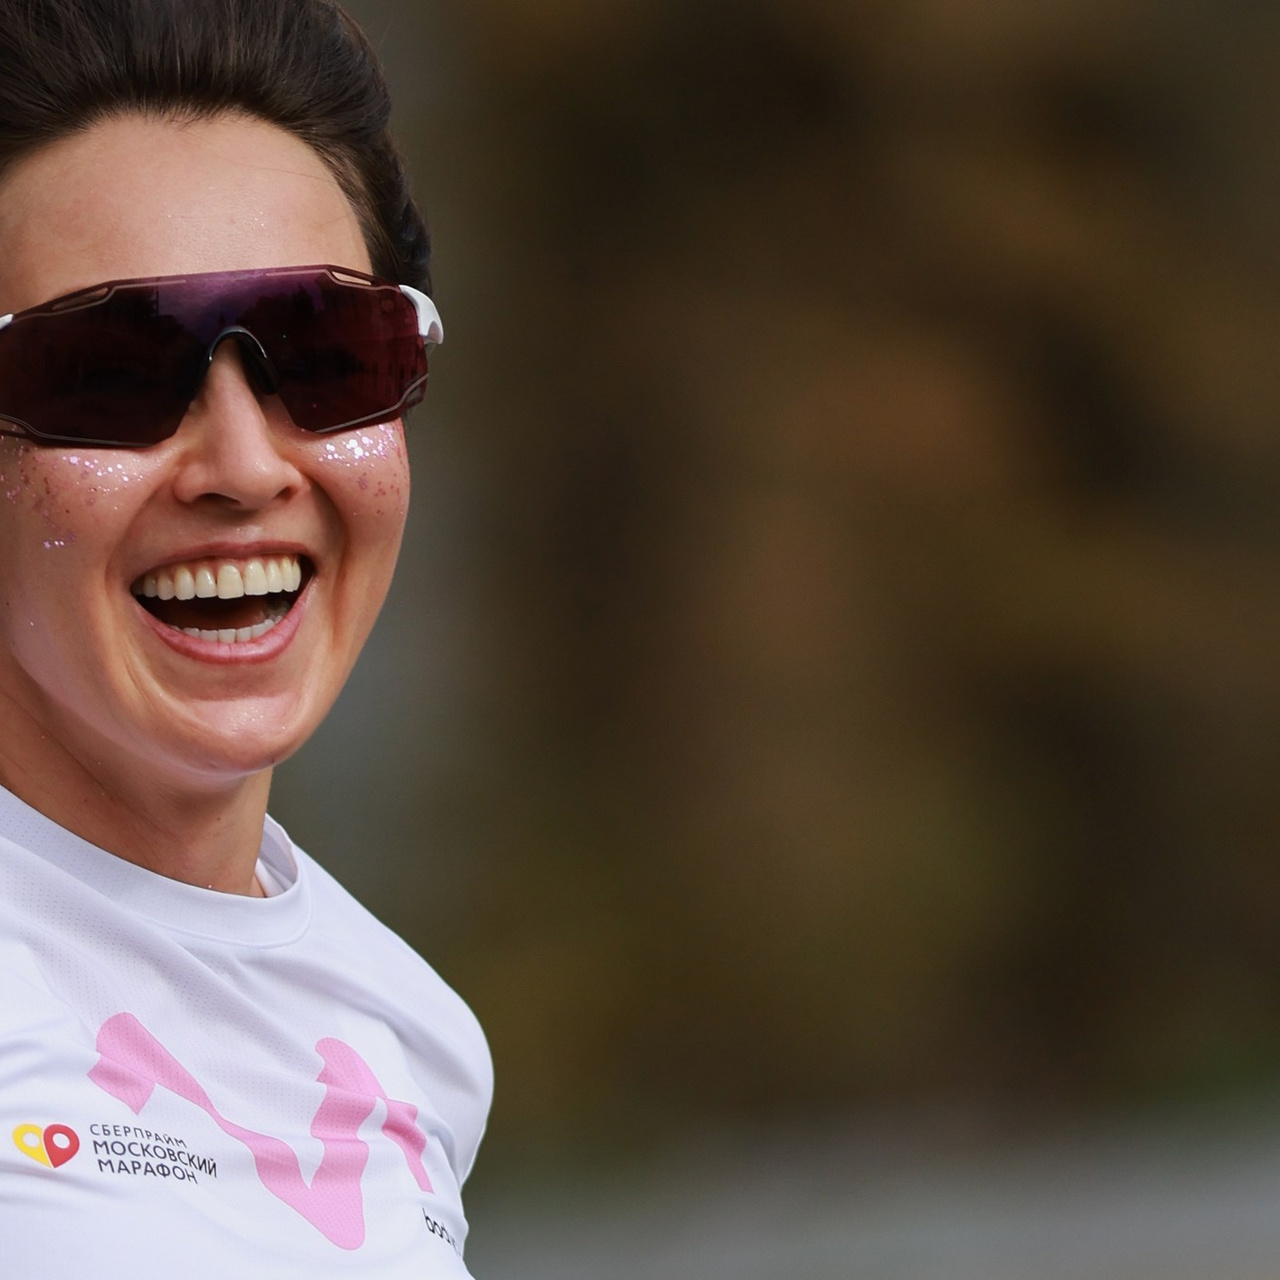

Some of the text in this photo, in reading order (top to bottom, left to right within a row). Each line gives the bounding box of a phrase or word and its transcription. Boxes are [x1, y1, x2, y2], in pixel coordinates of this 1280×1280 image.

[90, 1124, 188, 1148] СБЕРПРАЙМ
[93, 1140, 217, 1178] МОСКОВСКИЙ
[97, 1159, 199, 1184] МАРАФОН
